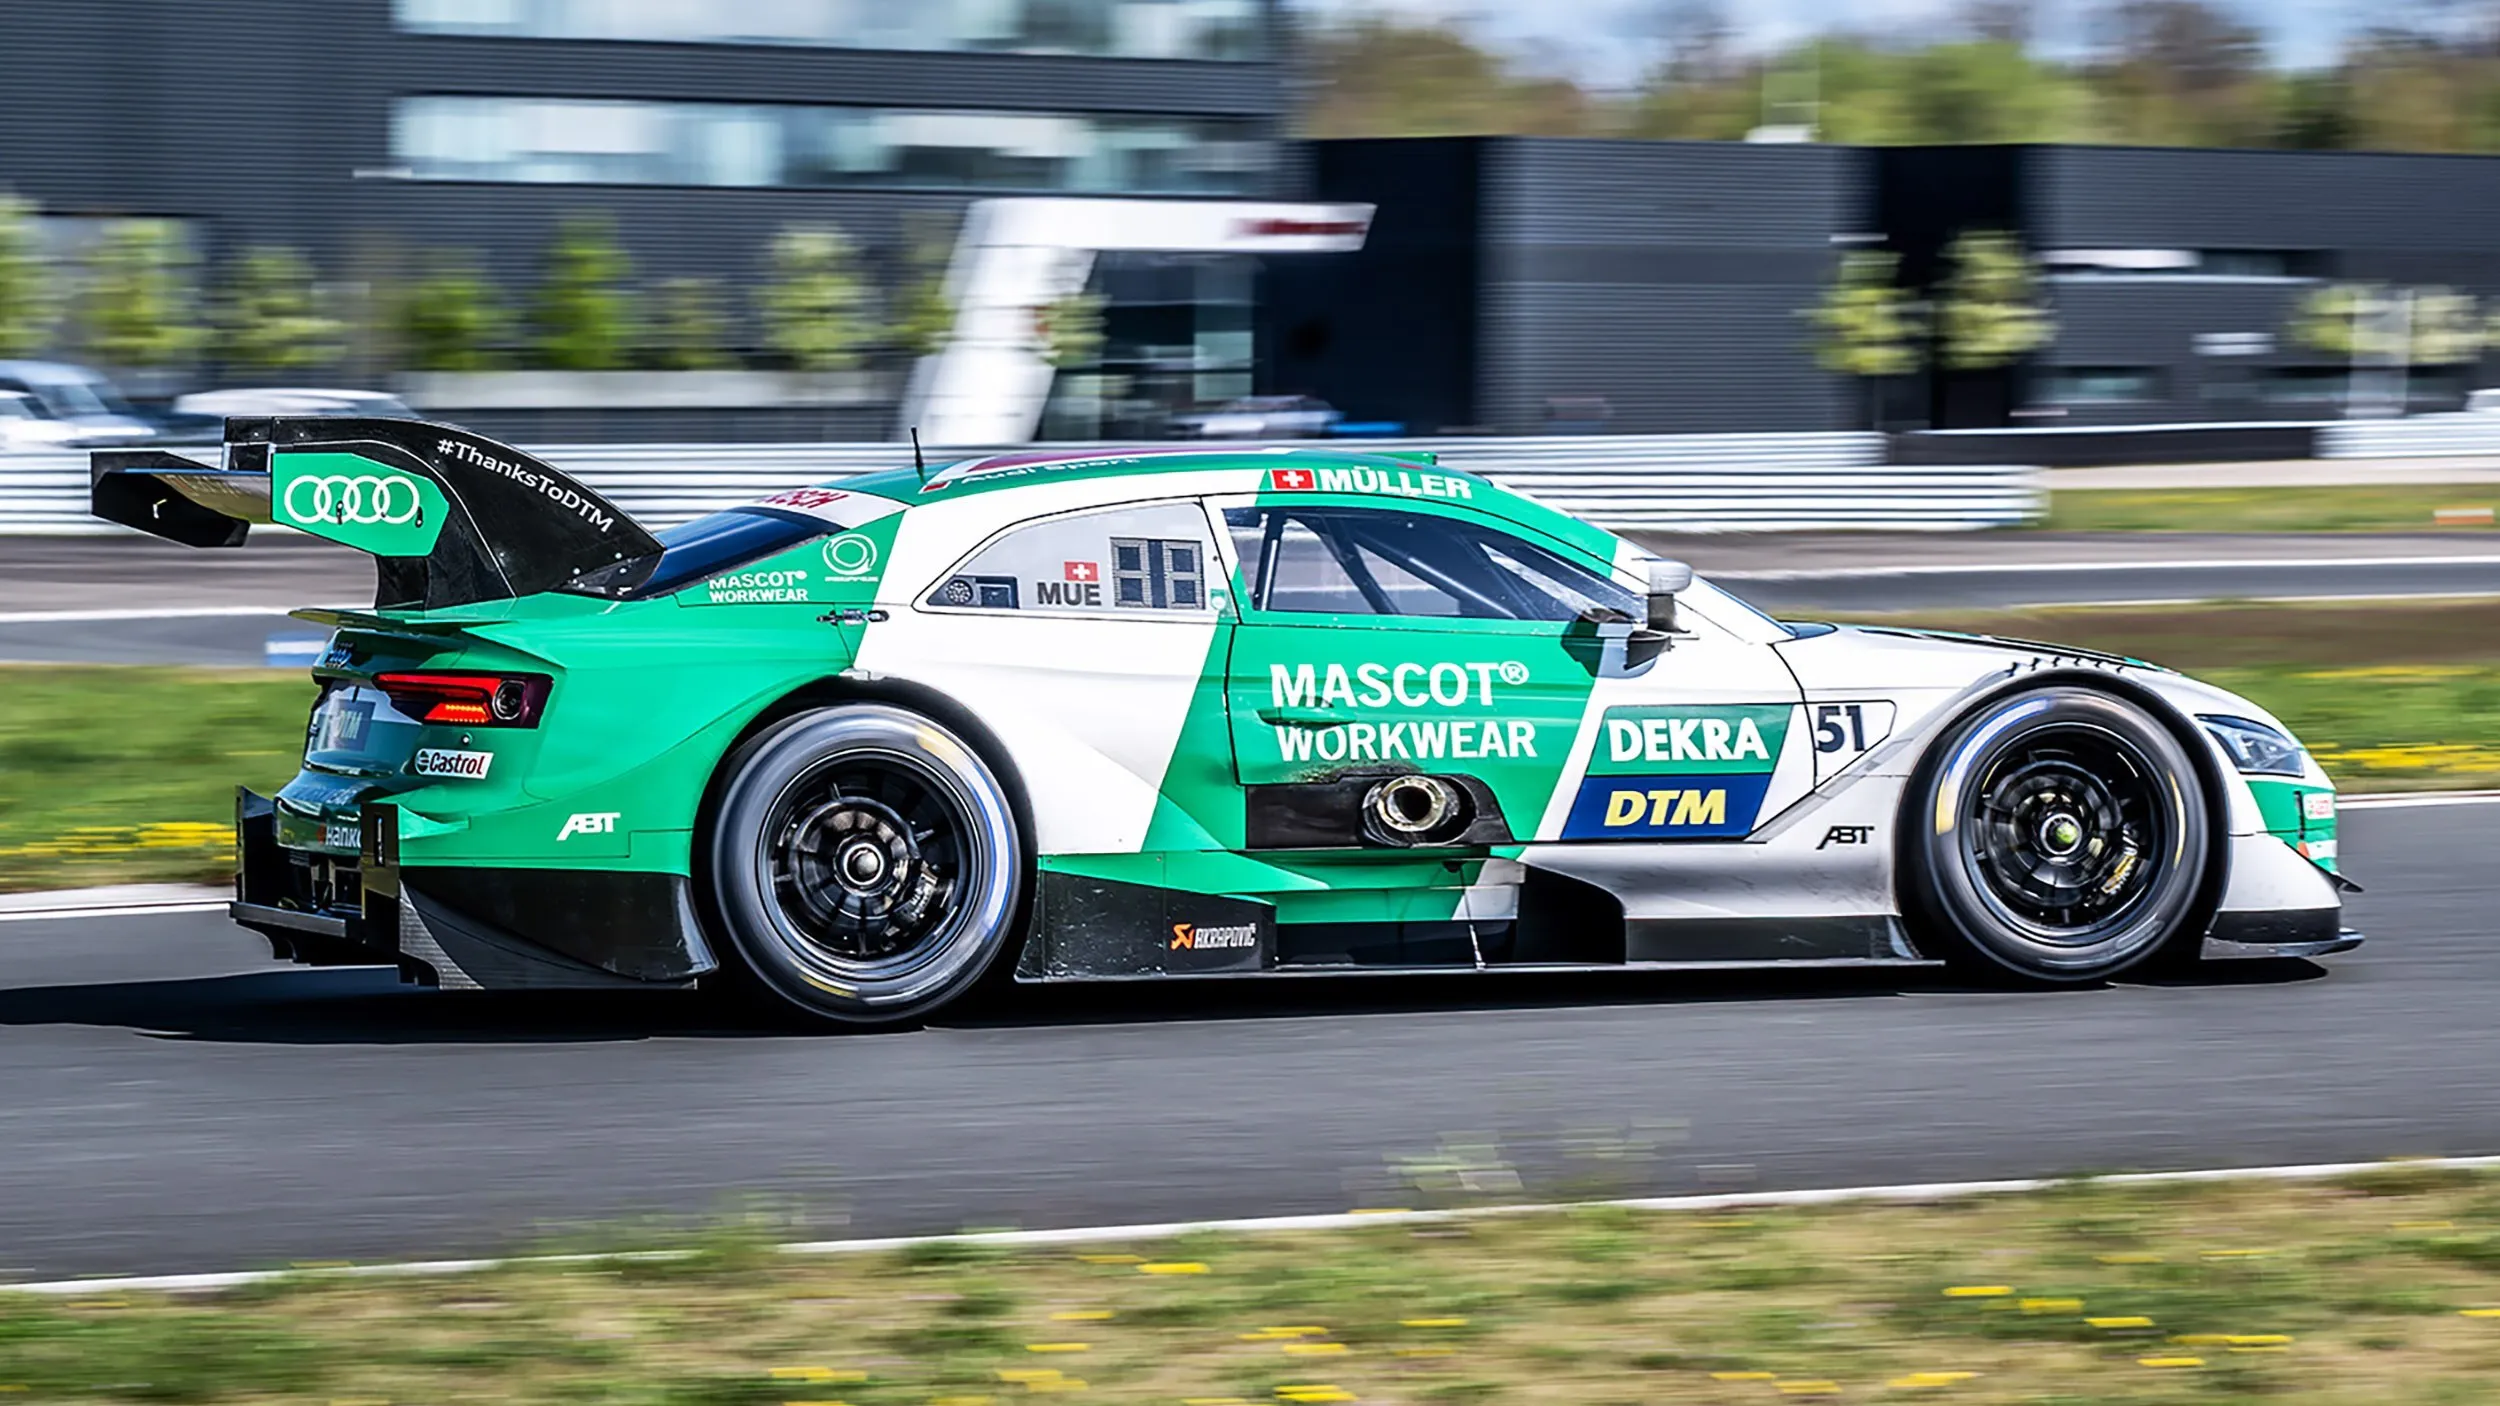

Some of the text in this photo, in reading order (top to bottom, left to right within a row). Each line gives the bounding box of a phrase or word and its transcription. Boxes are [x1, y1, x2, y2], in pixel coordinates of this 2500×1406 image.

[437, 439, 614, 532] #ThanksToDTM
[1319, 466, 1472, 499] MÜLLER
[709, 588, 808, 603] WORKWEAR
[1037, 582, 1102, 606] MUE
[1275, 721, 1537, 761] WORKWEAR
[1607, 717, 1770, 762] DEKRA
[1816, 705, 1866, 753] 51
[430, 752, 485, 776] Castrol
[1604, 789, 1726, 826] DTM
[556, 811, 621, 841] ABT
[1816, 826, 1874, 850] ABT
